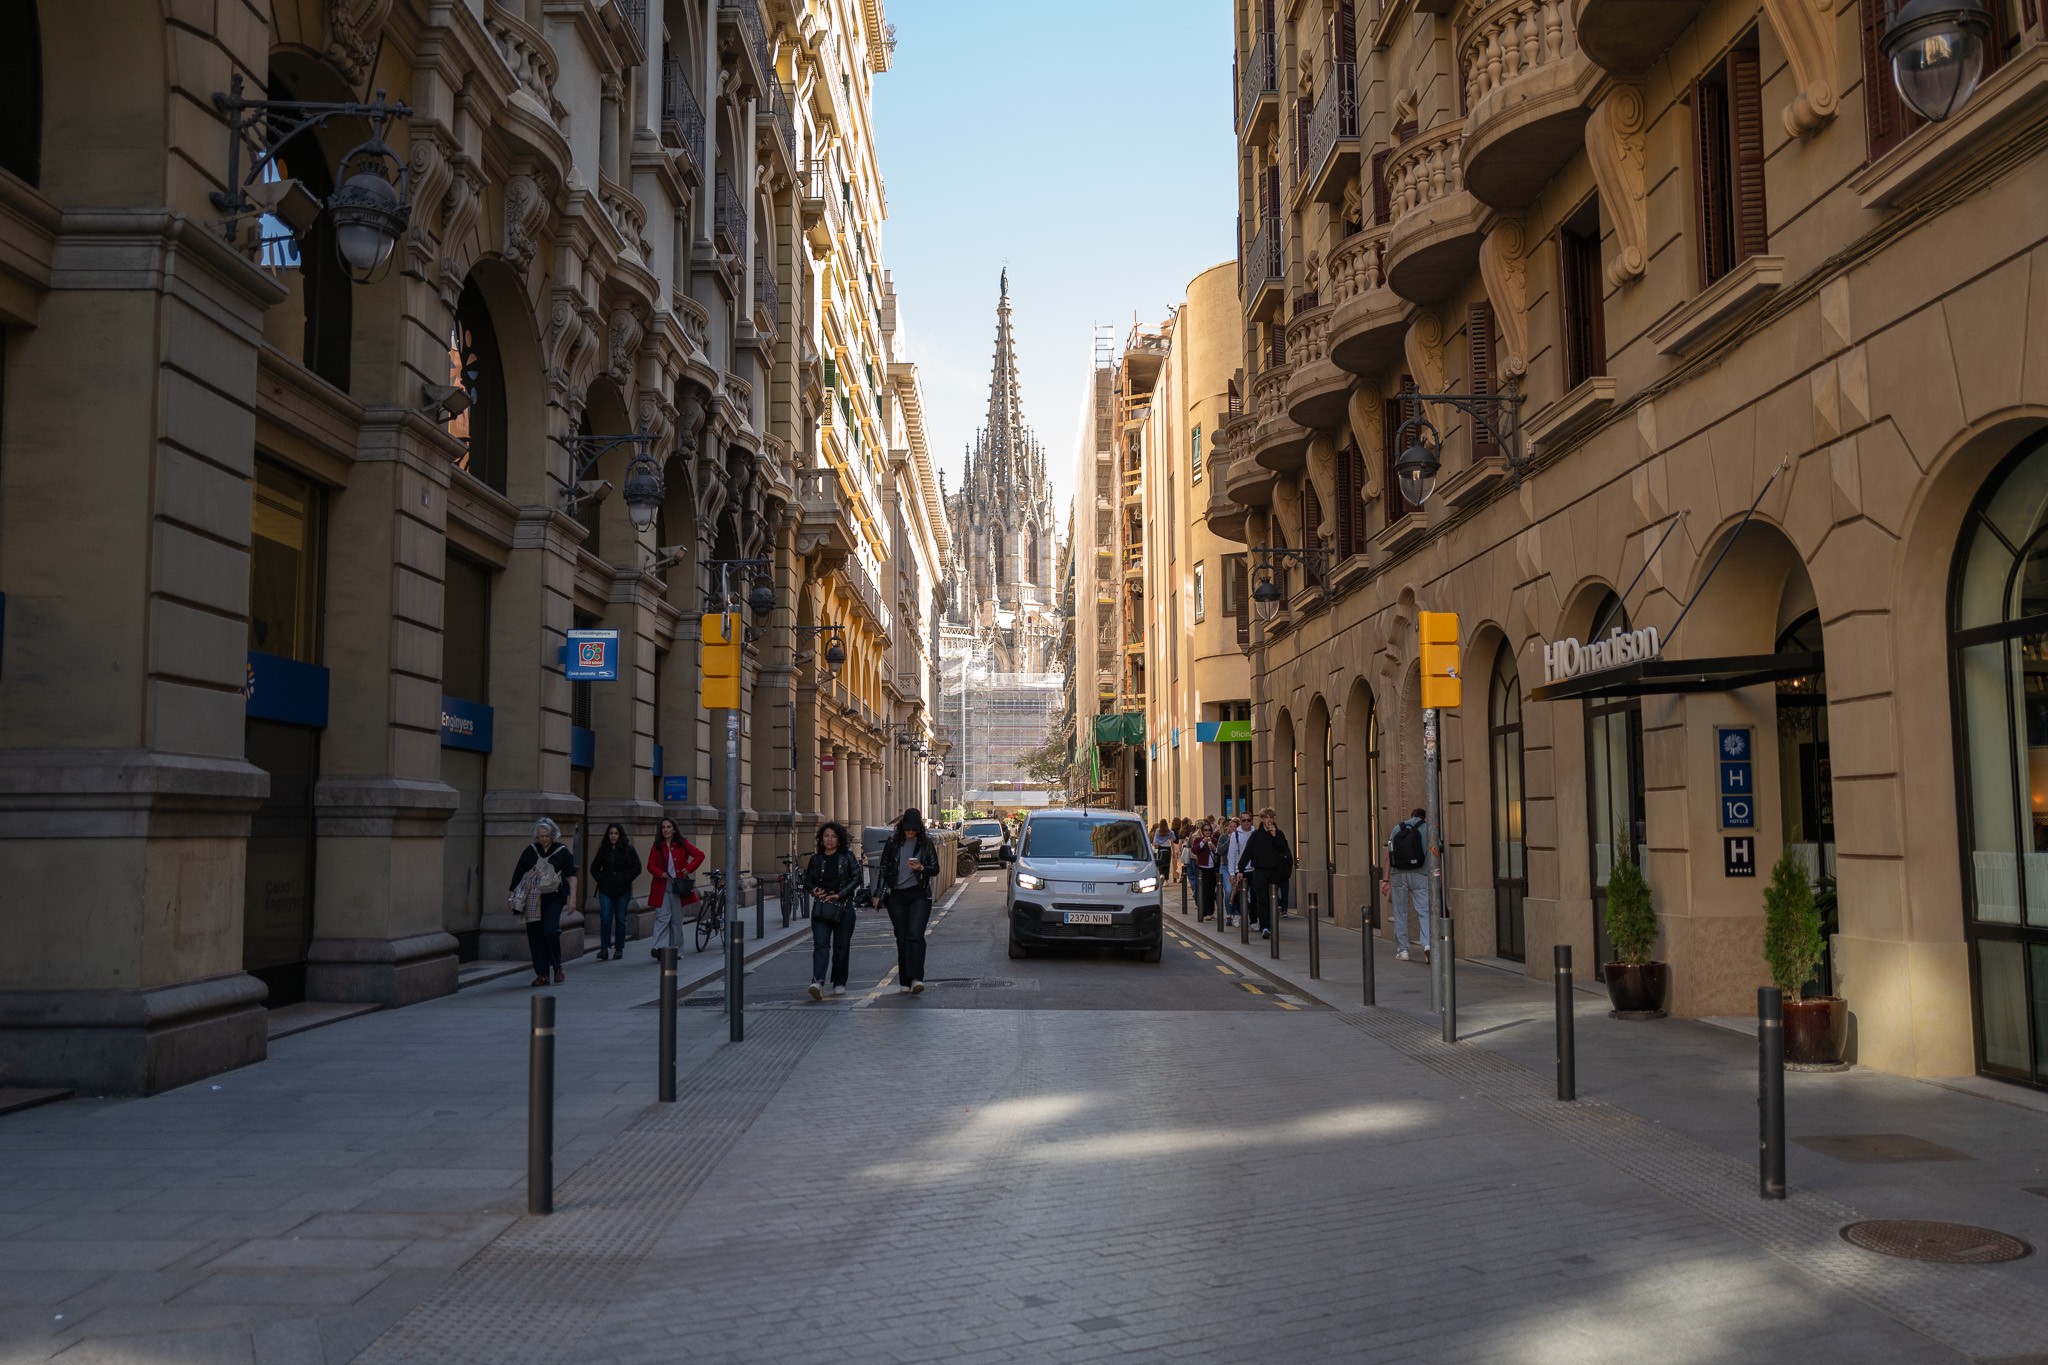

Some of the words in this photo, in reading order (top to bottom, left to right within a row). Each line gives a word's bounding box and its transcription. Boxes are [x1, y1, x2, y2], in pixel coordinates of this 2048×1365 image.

[441, 711, 474, 732] Enginyers
[1729, 769, 1743, 786] H
[1726, 802, 1749, 818] 10
[1730, 839, 1749, 863] H
[1081, 883, 1096, 894] FIAT
[1069, 913, 1090, 923] 2370
[1092, 914, 1109, 923] NHN
